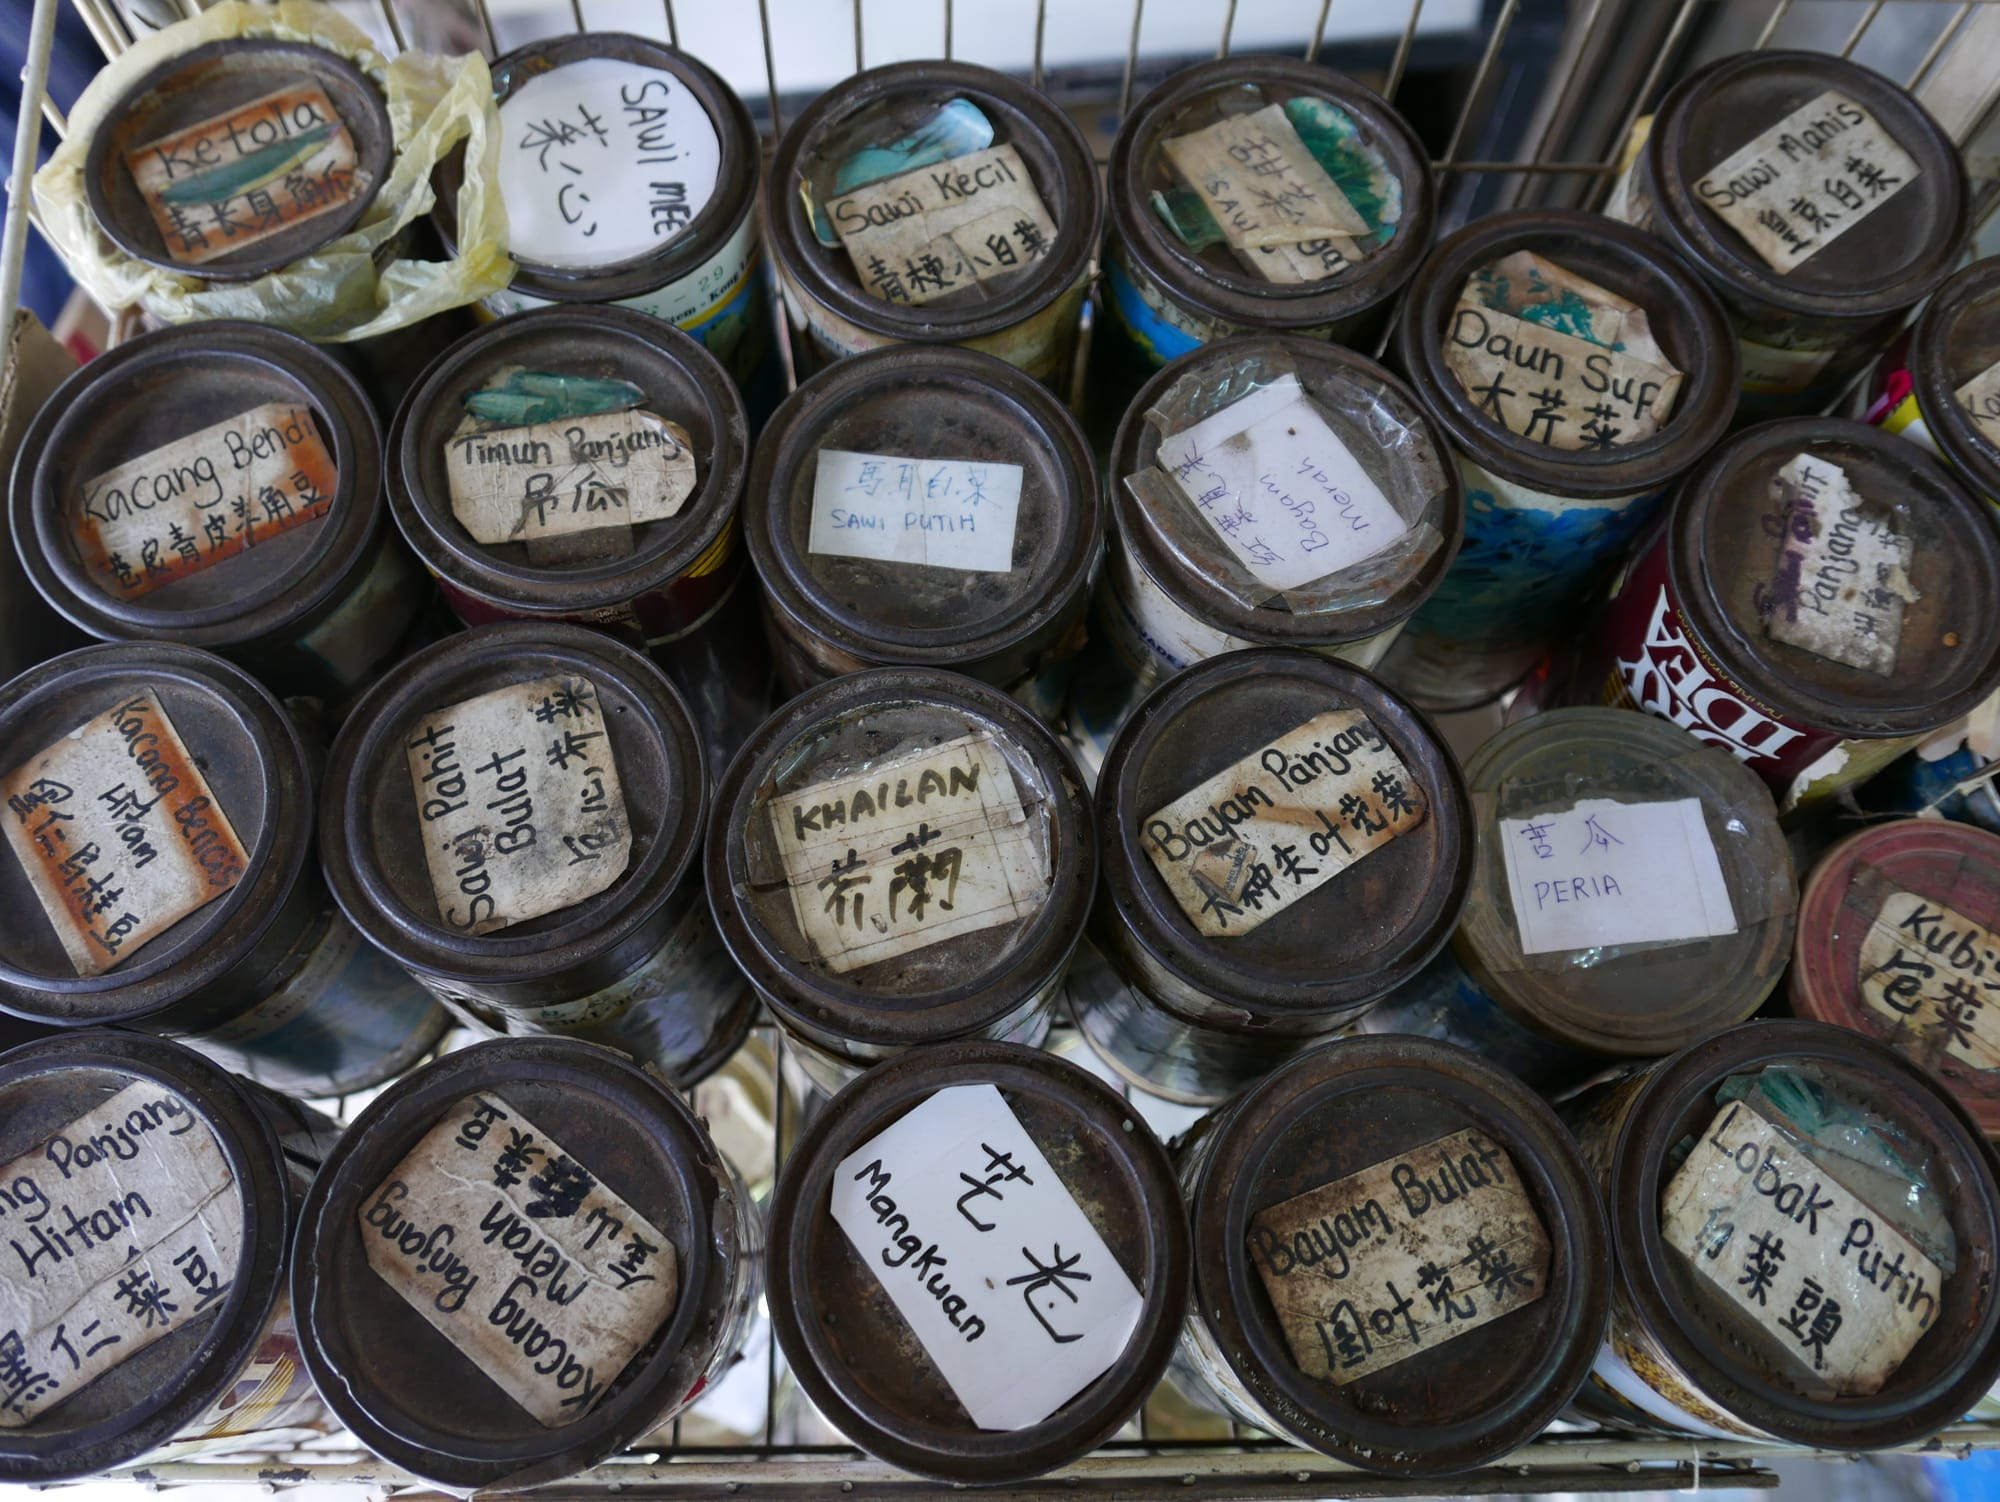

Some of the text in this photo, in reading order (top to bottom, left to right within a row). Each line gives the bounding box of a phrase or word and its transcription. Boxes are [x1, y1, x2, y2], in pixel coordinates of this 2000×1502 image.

[153, 102, 326, 179] Ketola
[1700, 103, 1865, 209] Sawi Manis
[835, 158, 1018, 235] Sawi Kecil
[1451, 309, 1565, 380] Daun
[83, 409, 315, 528] Kacang Bendi
[453, 426, 681, 468] Timun Panjang
[1297, 456, 1371, 532] Merah
[904, 513, 977, 533] PUTIH
[1258, 474, 1330, 553] Bayam
[1646, 583, 1807, 760] IDEA
[111, 696, 181, 819] Kacang
[792, 761, 981, 842] KHAILAN
[1147, 724, 1388, 863] Bayam Panjang
[409, 725, 496, 932] Sawi Pahit
[474, 747, 538, 876] Bulat
[1533, 874, 1622, 911] PERIA
[46, 1093, 197, 1180] Panjang
[10, 1190, 152, 1278] Hitam
[479, 1201, 590, 1306] Merah
[1256, 1136, 1506, 1280] Bayam Bulat
[1708, 1103, 1937, 1329] Lobak Putih
[364, 1180, 605, 1413] Kacang Panjang
